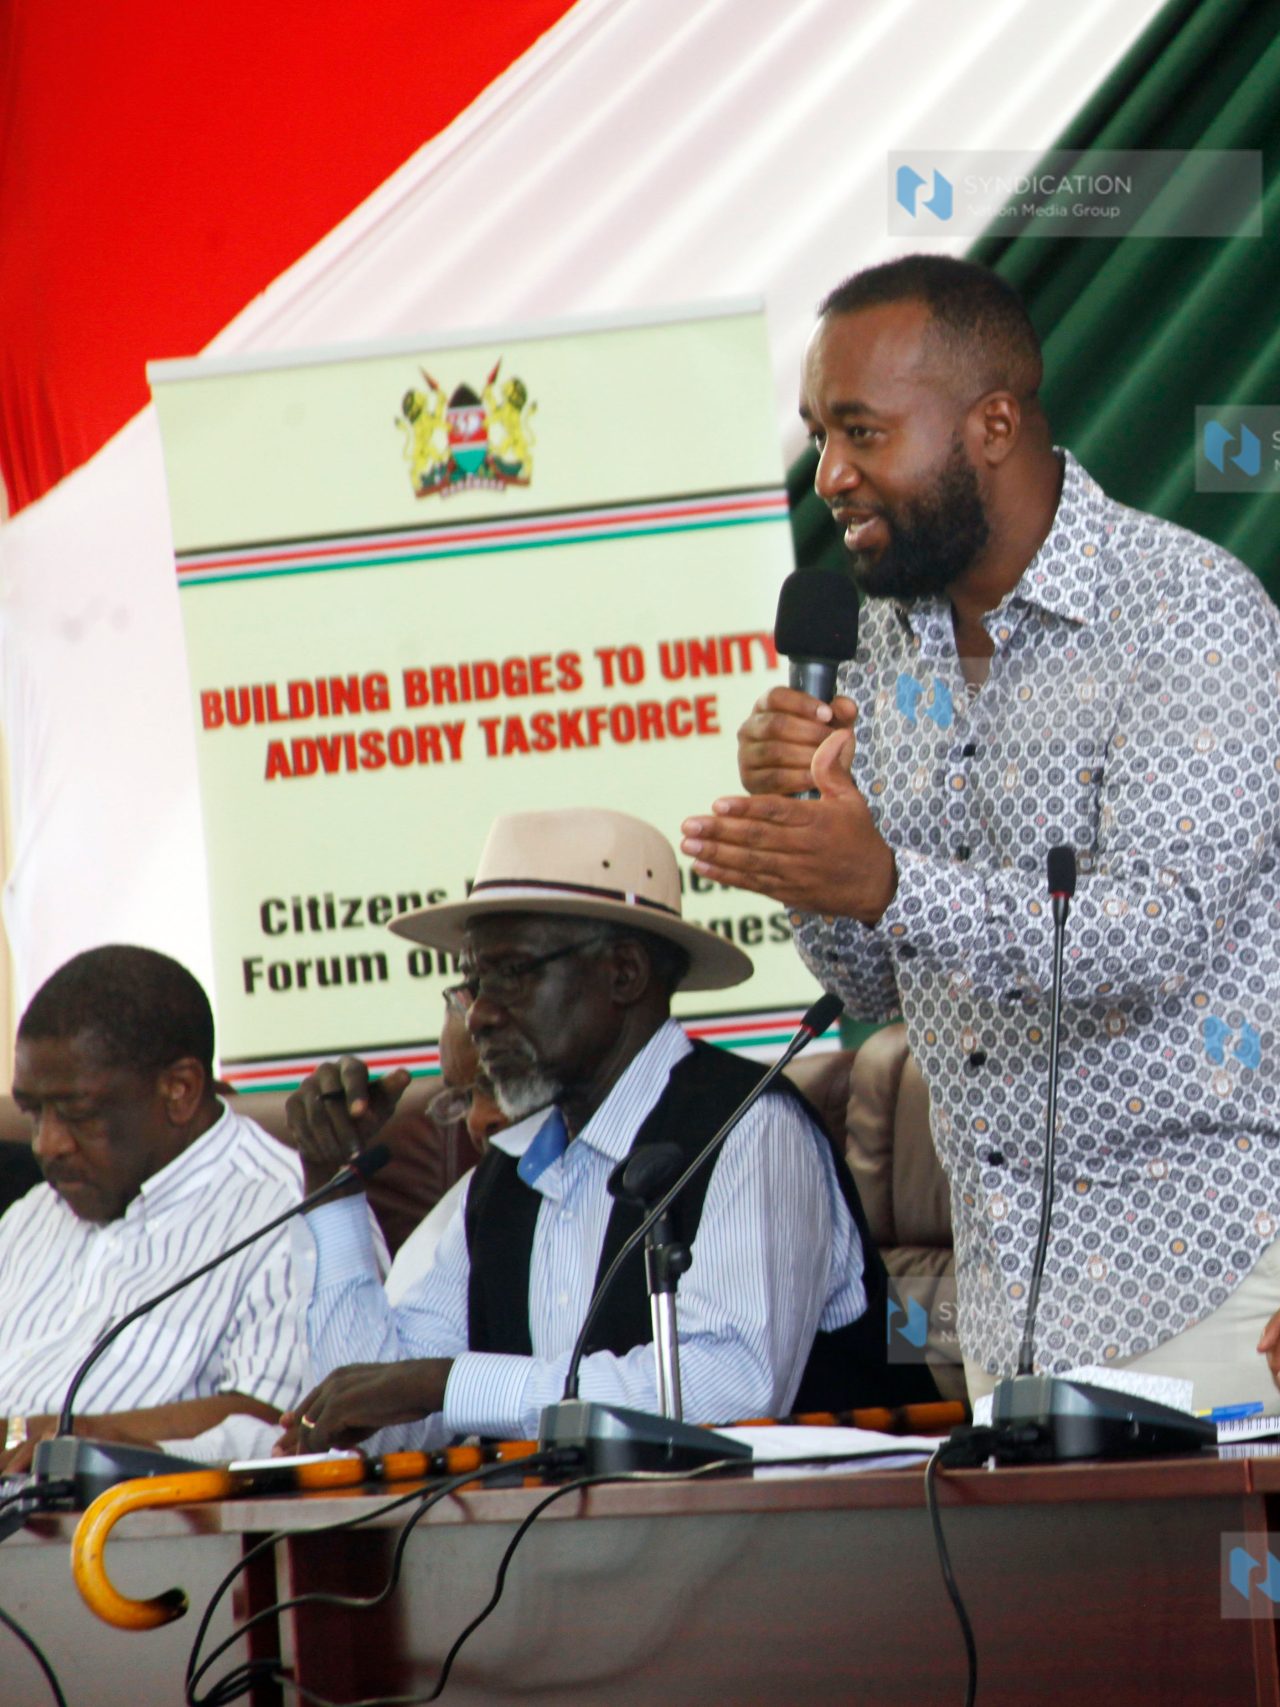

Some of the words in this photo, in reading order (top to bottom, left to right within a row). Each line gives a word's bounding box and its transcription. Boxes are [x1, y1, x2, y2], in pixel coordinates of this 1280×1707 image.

[200, 672, 390, 730] BUILDING
[403, 650, 584, 709] BRIDGES
[595, 643, 646, 688] TO
[658, 630, 778, 682] UNITY
[264, 720, 465, 782] ADVISORY
[478, 694, 720, 758] TASKFORCE
[242, 950, 388, 995] Forum
